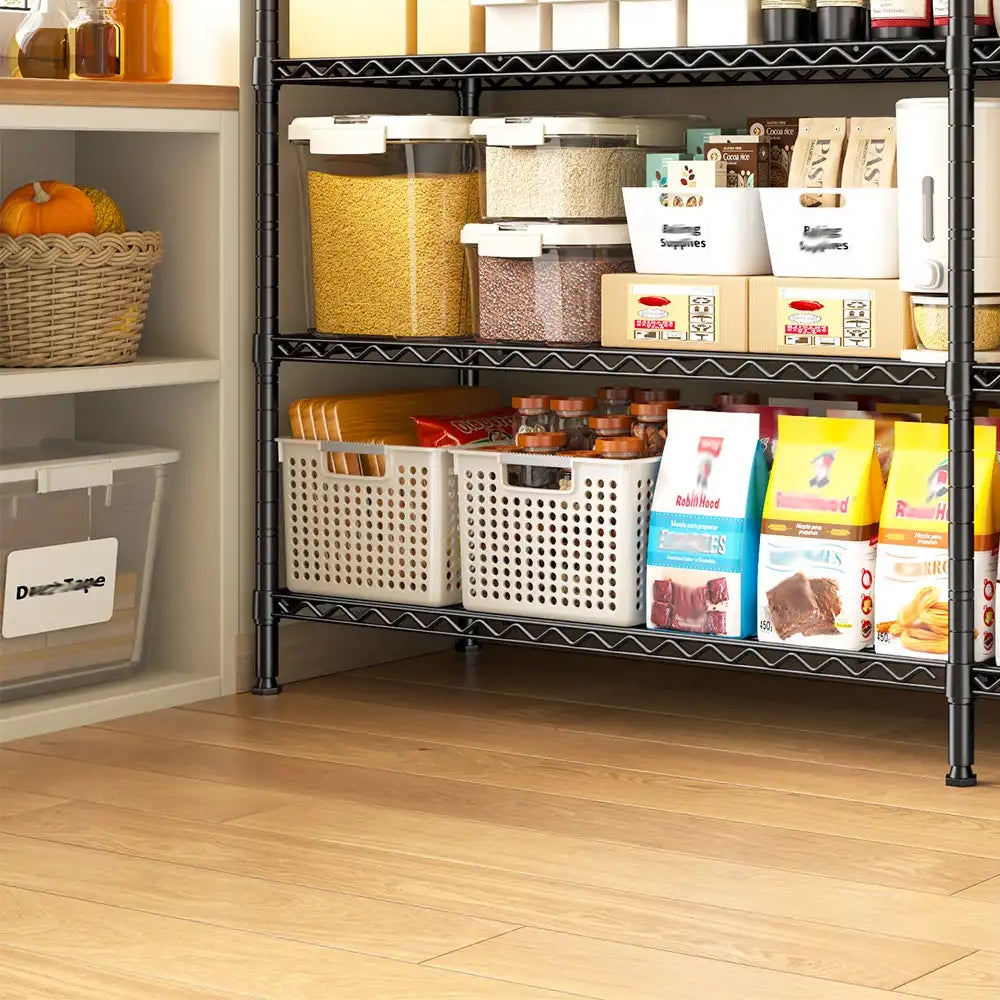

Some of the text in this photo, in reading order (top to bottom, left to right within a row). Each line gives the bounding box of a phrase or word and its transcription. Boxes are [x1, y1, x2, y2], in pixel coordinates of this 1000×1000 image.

[766, 127, 795, 136] Cocoa rice
[722, 152, 751, 161] Cocoa rice
